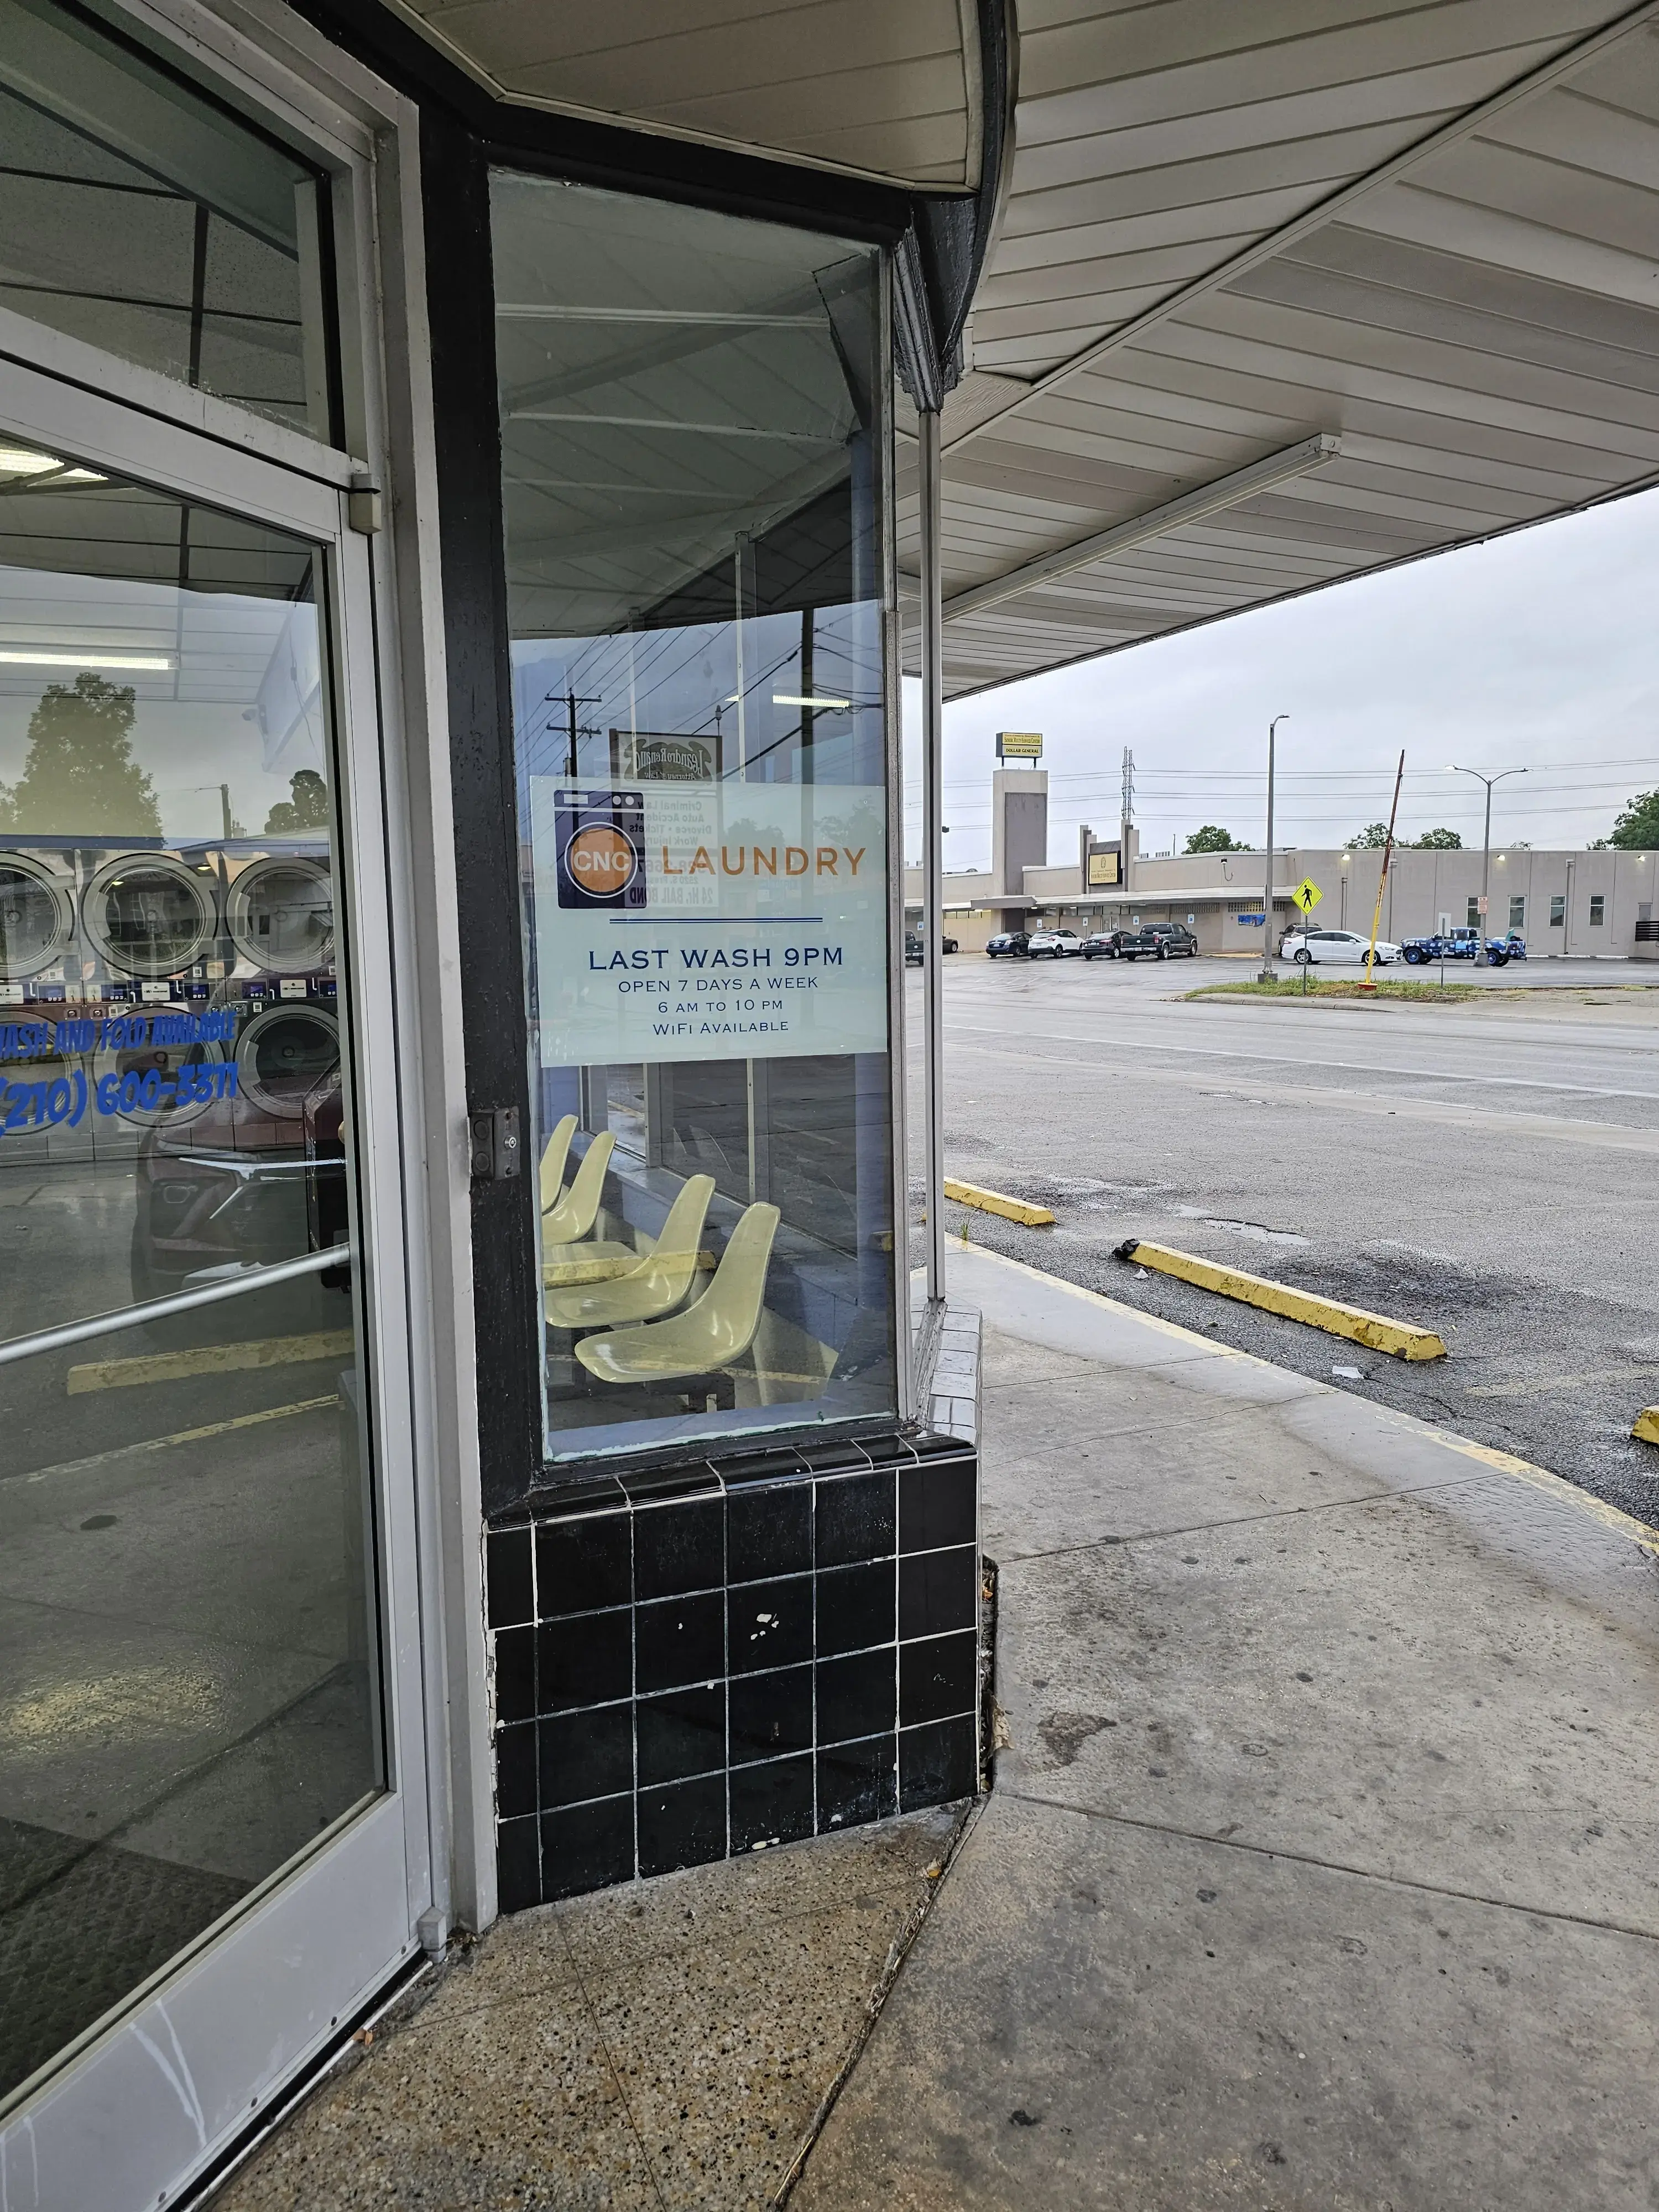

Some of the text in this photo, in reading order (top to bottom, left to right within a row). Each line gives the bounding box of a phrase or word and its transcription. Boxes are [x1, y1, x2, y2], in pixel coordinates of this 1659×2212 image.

[573, 850, 630, 872] CNC
[663, 846, 866, 875] LAUNDRY
[589, 947, 843, 971] LAST WASH 9PM
[618, 977, 818, 993] OPEN 7 DAYS A WEEK
[658, 999, 783, 1013] 6 AM TO 10 PM
[54, 1020, 95, 1055] AND
[101, 1017, 146, 1051] FOLD
[152, 1011, 237, 1046] AVAILABLE
